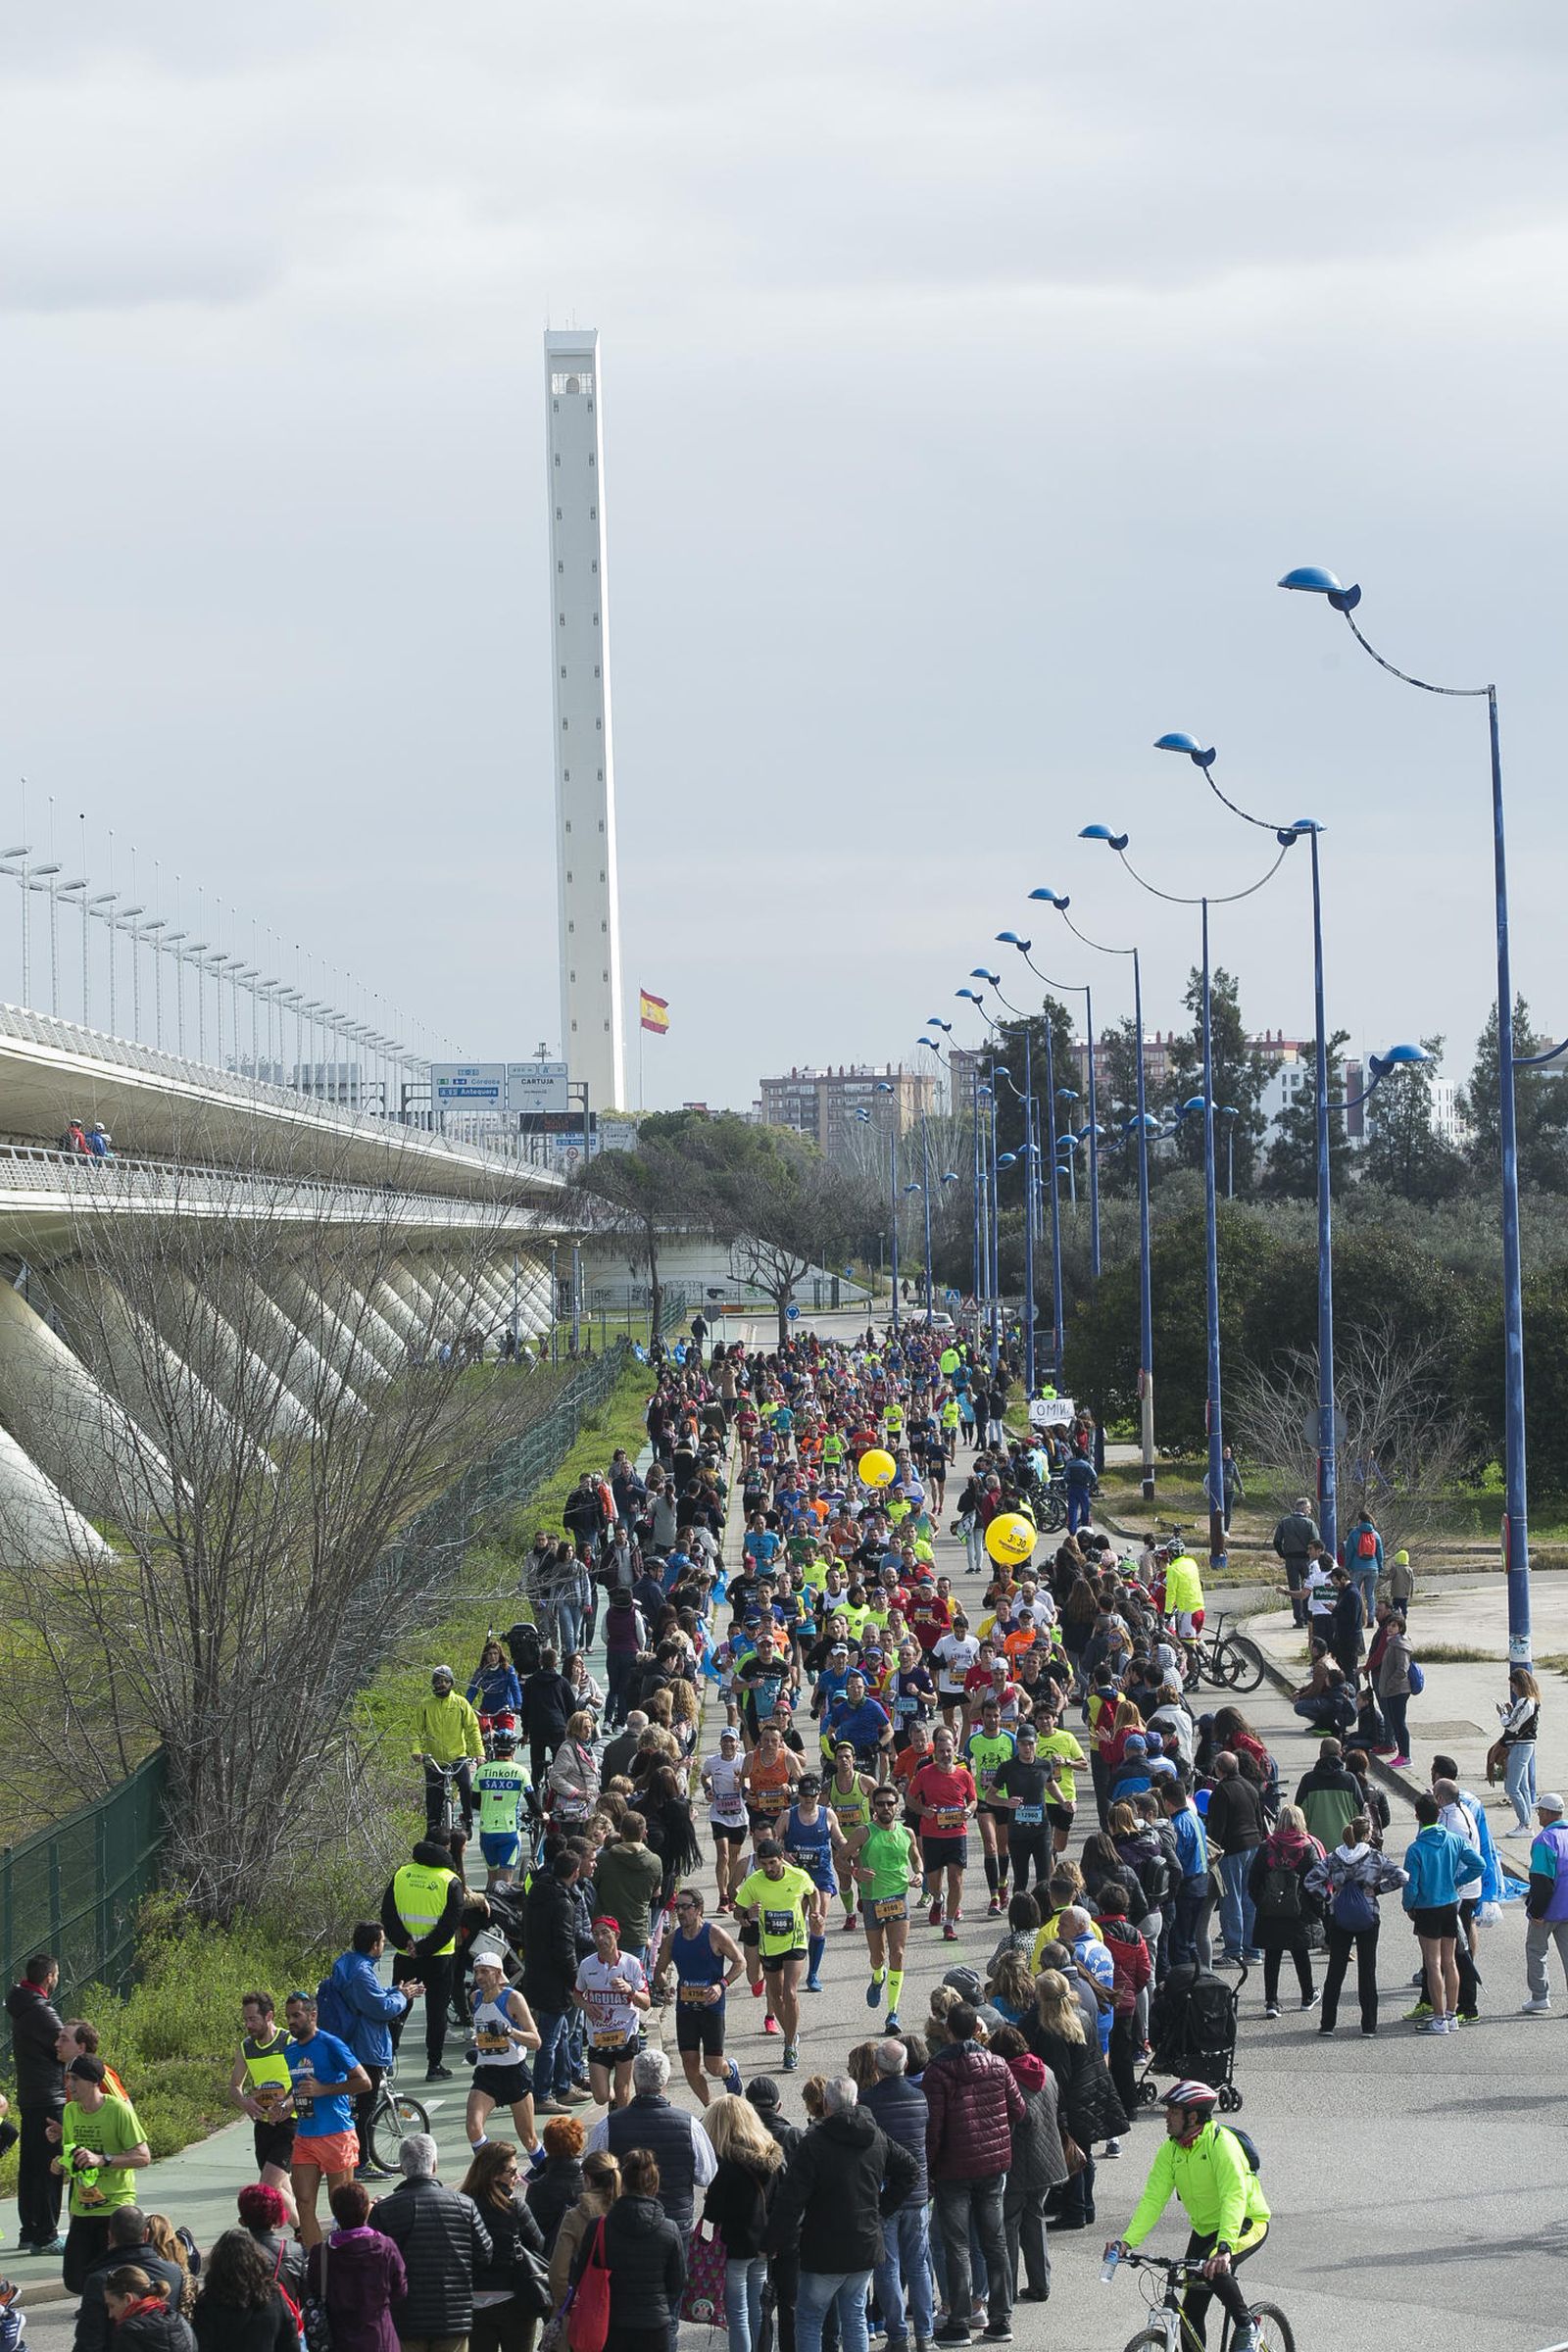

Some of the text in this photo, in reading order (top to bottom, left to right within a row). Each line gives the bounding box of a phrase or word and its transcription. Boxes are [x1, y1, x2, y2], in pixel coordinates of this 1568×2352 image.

[484, 1769, 518, 1779] Tinkoff
[485, 1780, 514, 1789] SAXO
[589, 1991, 629, 2005] AGUIAS
